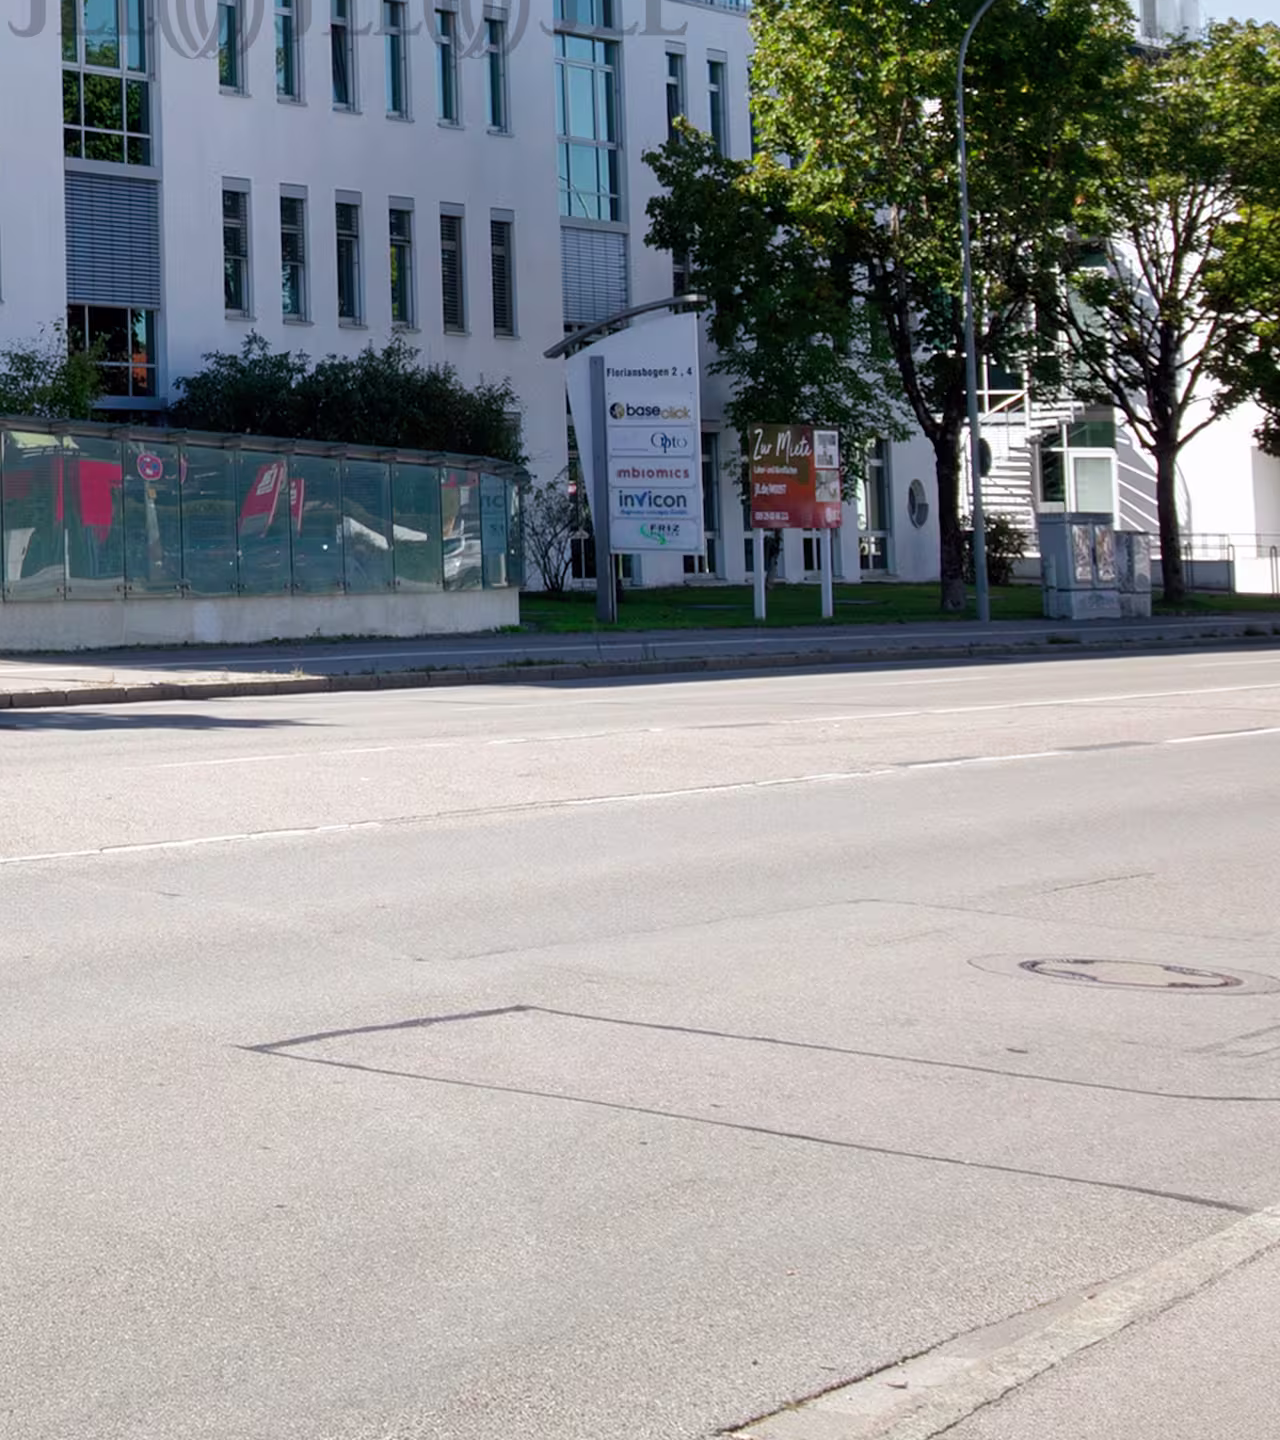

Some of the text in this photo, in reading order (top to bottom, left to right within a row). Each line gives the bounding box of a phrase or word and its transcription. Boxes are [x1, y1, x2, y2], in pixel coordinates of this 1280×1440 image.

[606, 367, 669, 378] Floriansbogen
[671, 366, 678, 376] 2
[686, 367, 693, 375] 4
[650, 432, 688, 453] Opto
[753, 428, 812, 464] Zur Miete
[619, 490, 687, 508] invicon
